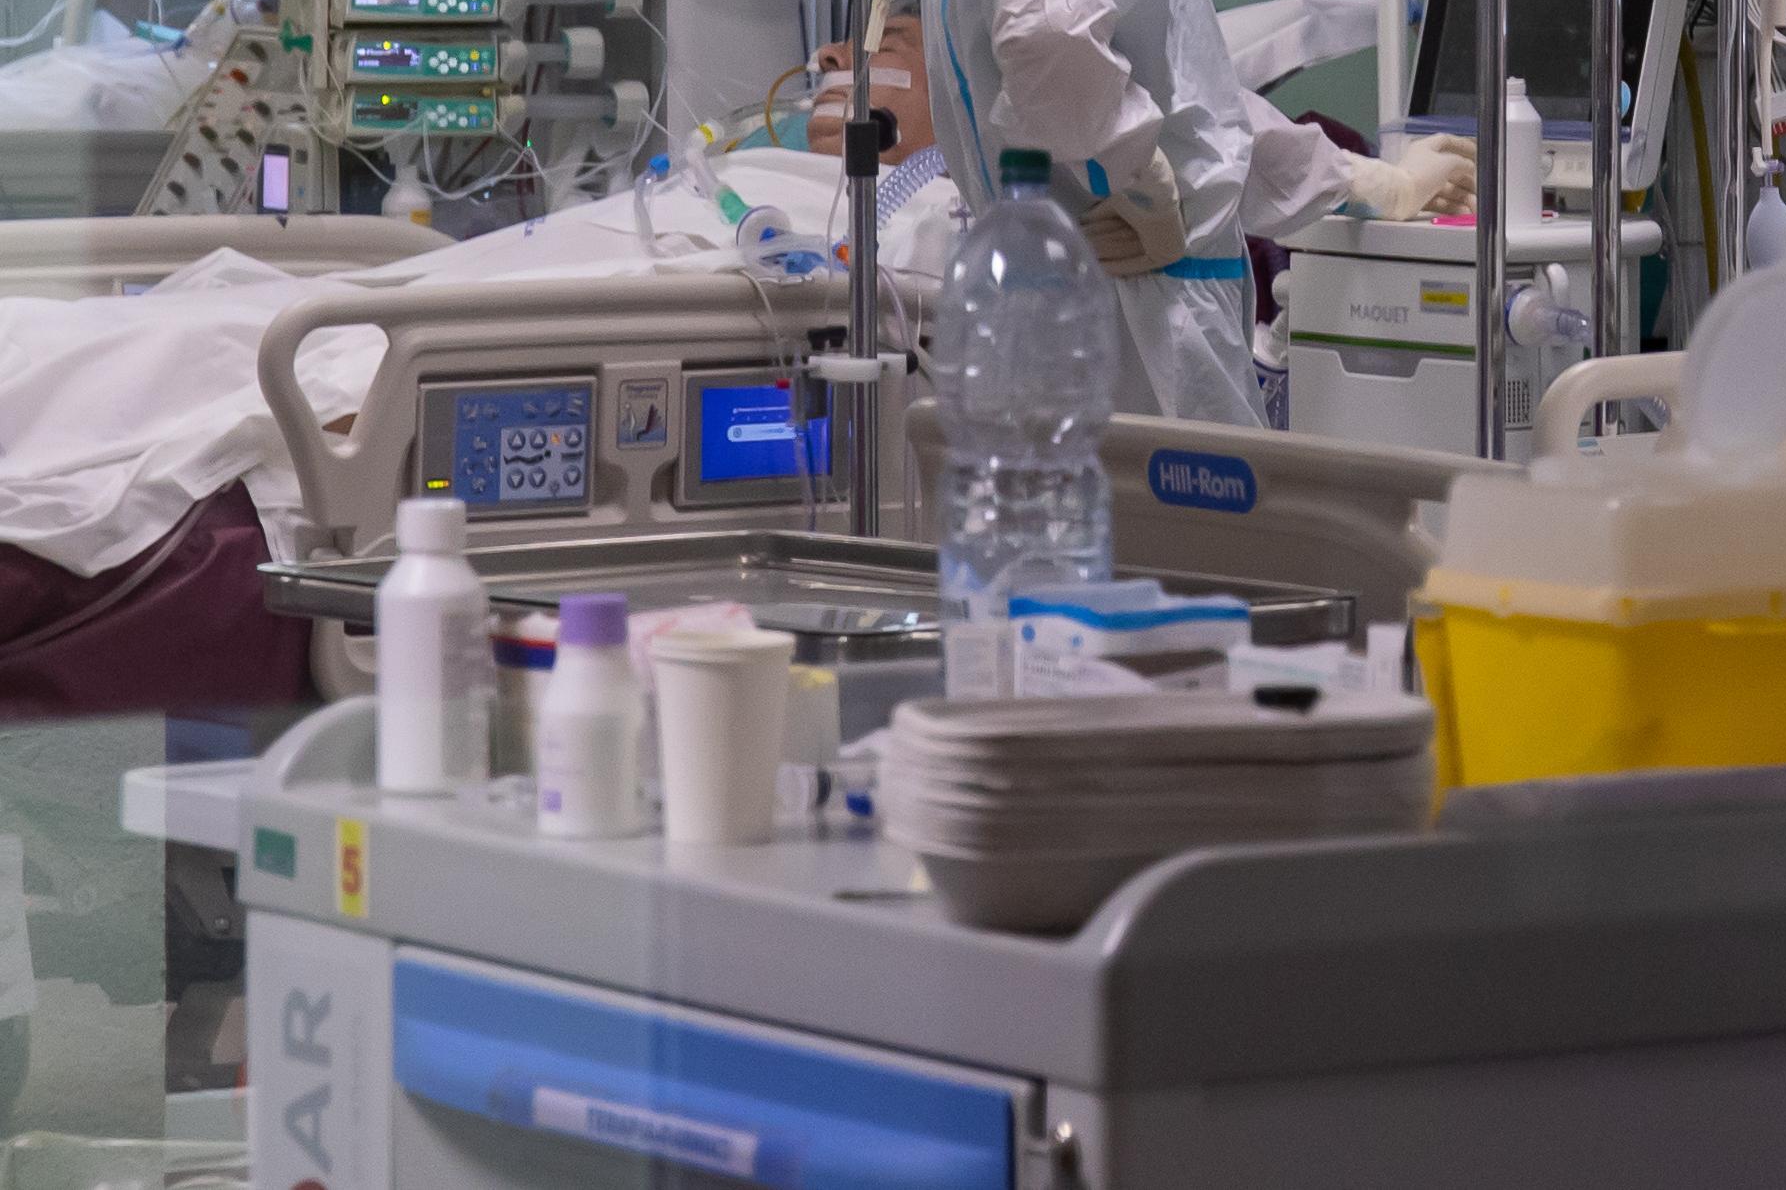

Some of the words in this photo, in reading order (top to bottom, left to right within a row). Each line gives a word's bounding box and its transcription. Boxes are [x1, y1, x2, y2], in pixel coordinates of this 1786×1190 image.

[1349, 303, 1409, 324] MAQUET
[1159, 461, 1247, 501] Hill-Rom
[340, 845, 363, 897] 5
